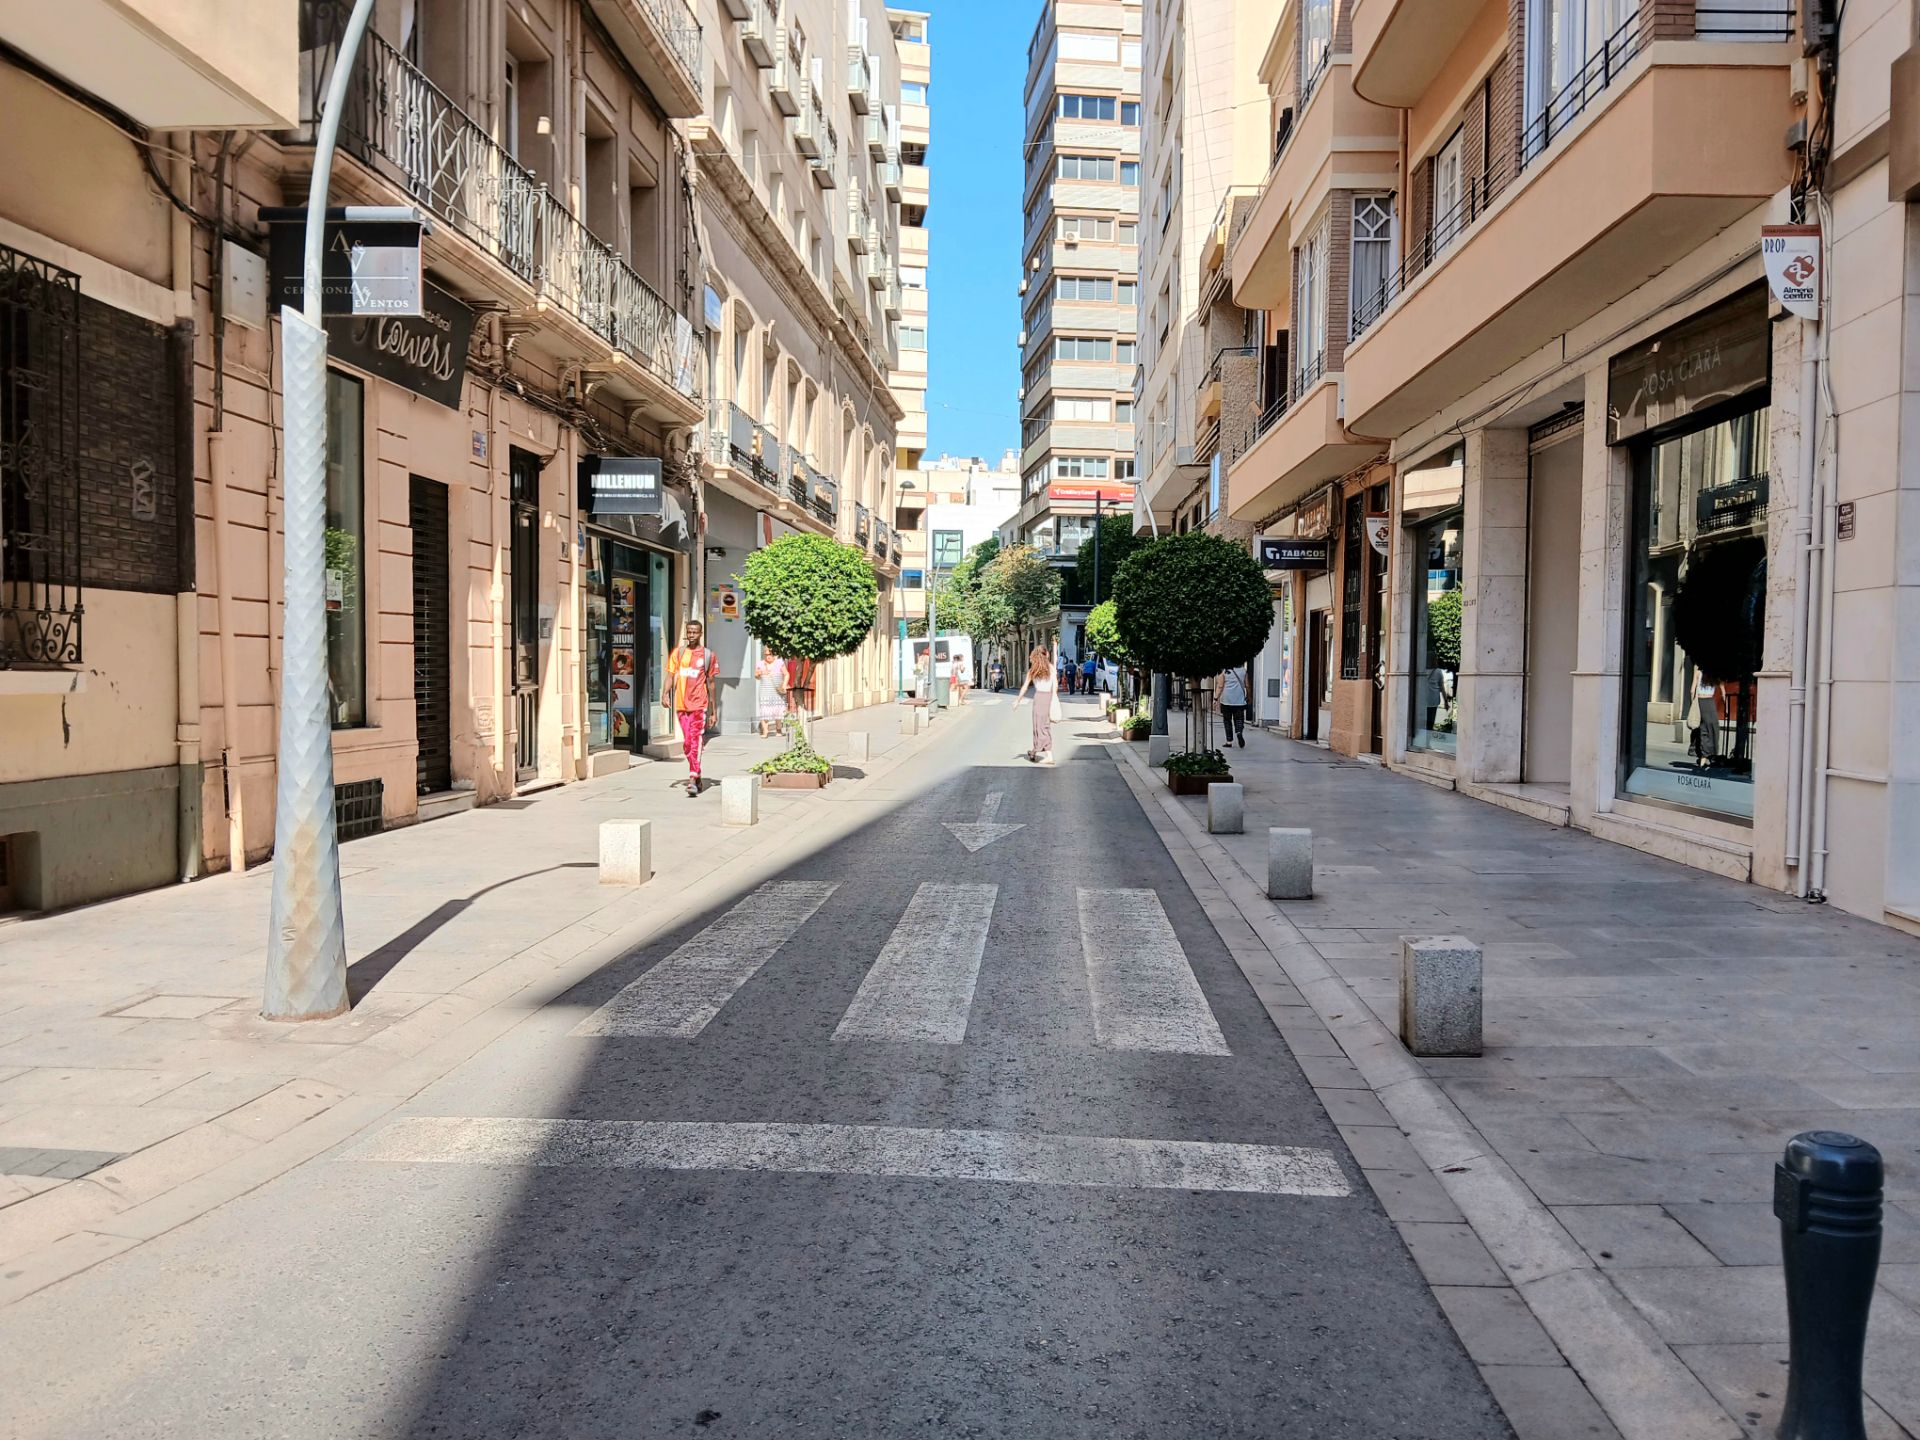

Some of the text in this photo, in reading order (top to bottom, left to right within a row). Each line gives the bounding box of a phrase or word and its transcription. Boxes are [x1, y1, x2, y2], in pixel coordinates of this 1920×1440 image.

[1764, 238, 1786, 253] DROP
[1642, 339, 1722, 398] ROSA CLARÁ
[591, 474, 655, 489] MILLENIUM
[1281, 549, 1326, 557] TABACOS
